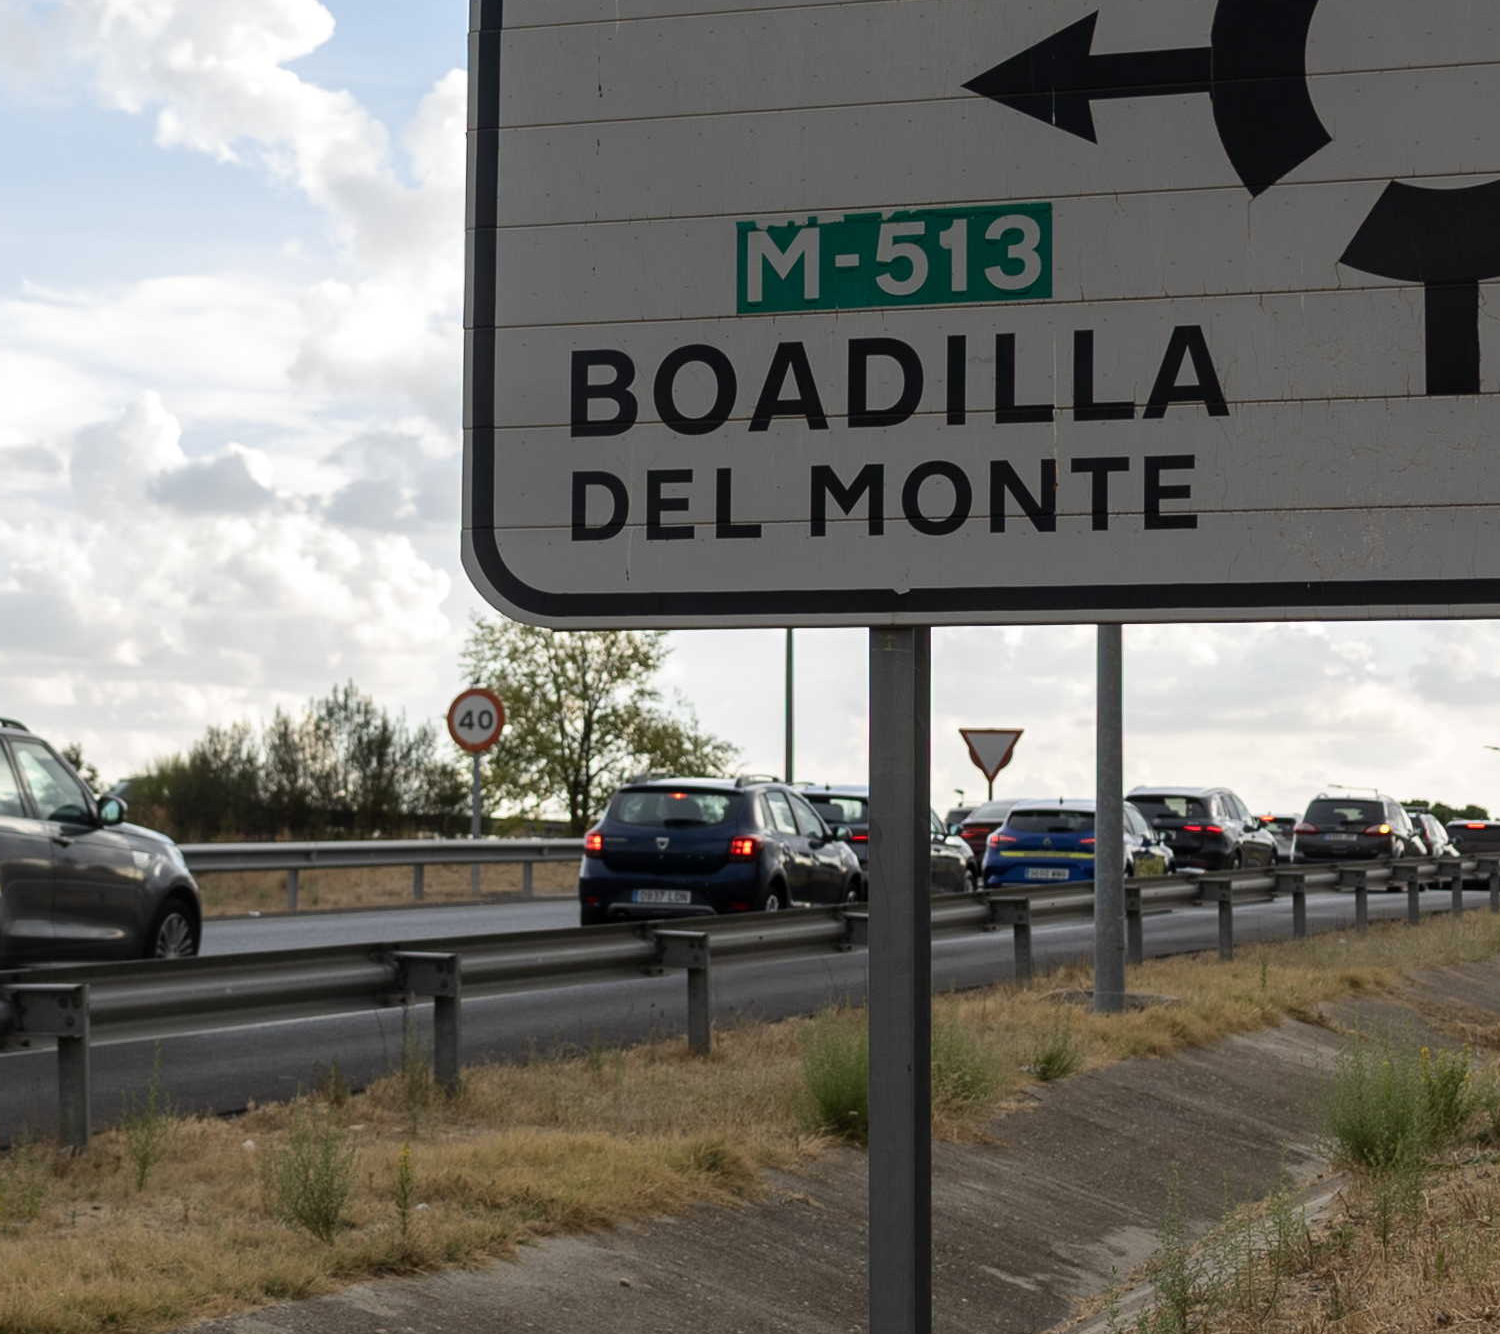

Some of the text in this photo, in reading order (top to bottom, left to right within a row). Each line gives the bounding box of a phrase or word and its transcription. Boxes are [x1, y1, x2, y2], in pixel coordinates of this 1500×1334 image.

[746, 214, 1042, 303] M-513
[569, 324, 1232, 438] BOADILLA
[571, 454, 1199, 542] DEL MONTE
[458, 709, 494, 731] 40
